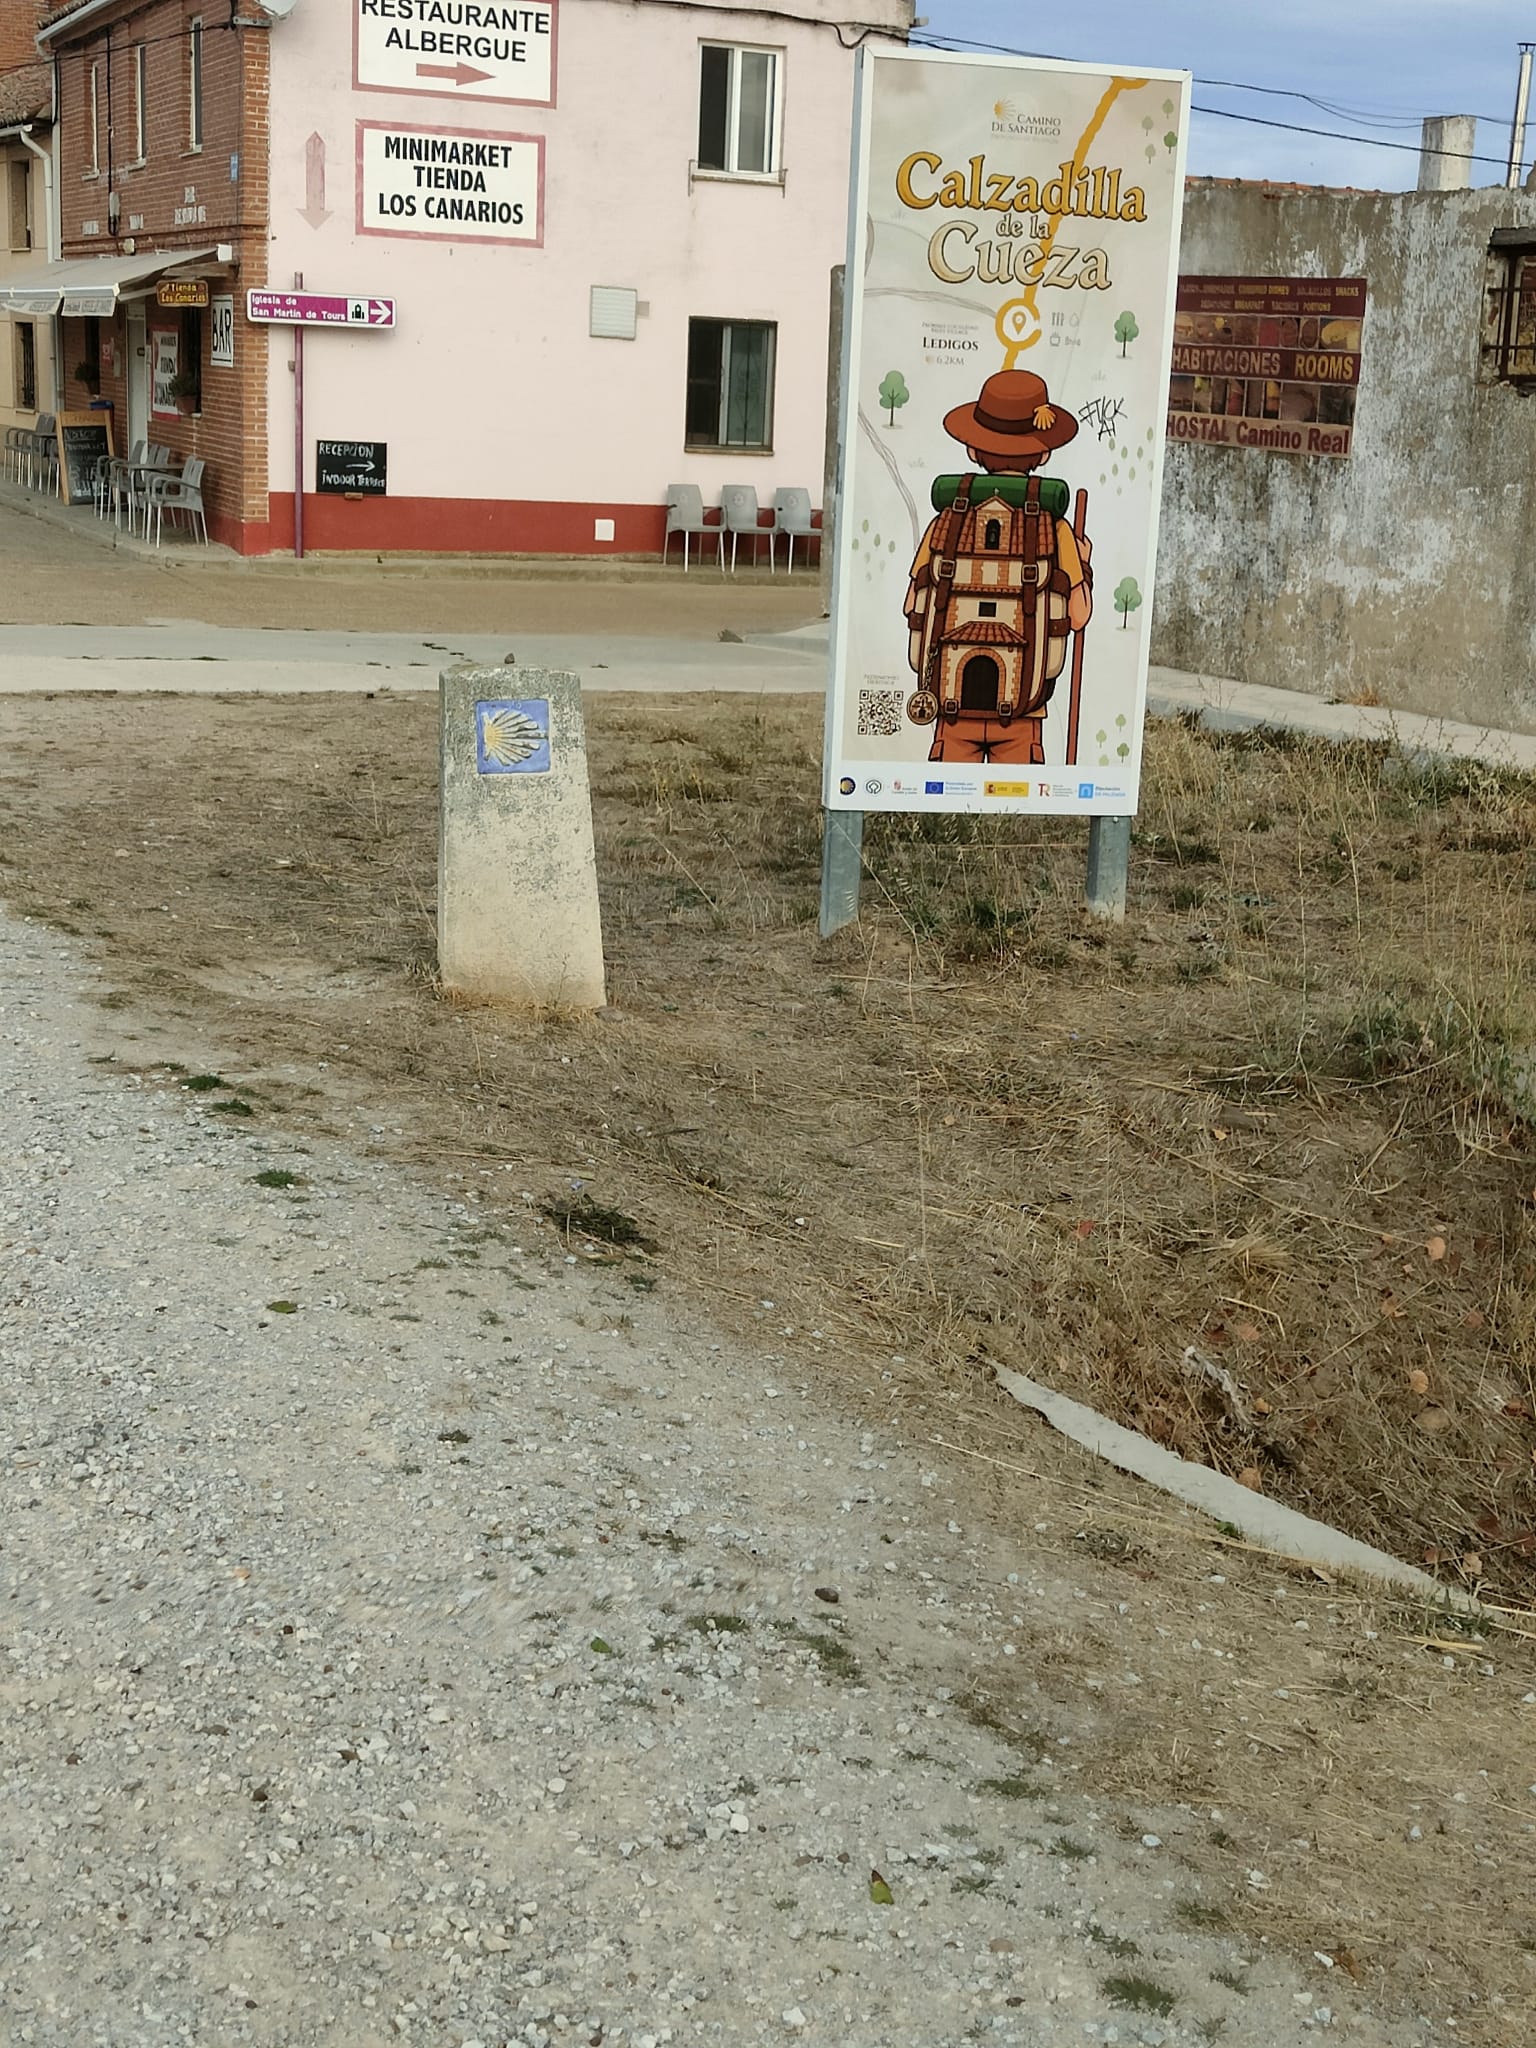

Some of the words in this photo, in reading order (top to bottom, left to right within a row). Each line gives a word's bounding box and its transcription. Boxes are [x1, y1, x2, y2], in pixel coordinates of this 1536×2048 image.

[361, 0, 550, 34] RESTAURANTE
[385, 27, 526, 62] ALBERGUE
[991, 121, 1005, 132] DE
[1008, 123, 1061, 136] SANTIAGO
[1017, 113, 1061, 126] CAMINO
[384, 136, 512, 168] MINIMARKET
[413, 165, 486, 193] TIENDA
[895, 150, 1147, 222] Calzadilla
[379, 193, 416, 217] LOS
[424, 197, 524, 225] CANARIOS
[996, 212, 1023, 238] de
[1029, 215, 1051, 239] la
[927, 220, 1112, 290] Cueza
[252, 295, 281, 305] Iglesia
[285, 297, 297, 305] de
[252, 308, 269, 316] San
[306, 310, 317, 318] de
[321, 311, 345, 320] Tours
[213, 308, 231, 353] BAR
[923, 336, 979, 351] LEDIGOS
[1172, 348, 1280, 376] HABITACIONES
[1295, 354, 1353, 380] ROOMS
[1166, 415, 1230, 442] HOSTAL
[1236, 421, 1302, 449] Camino
[1308, 428, 1349, 454] Real
